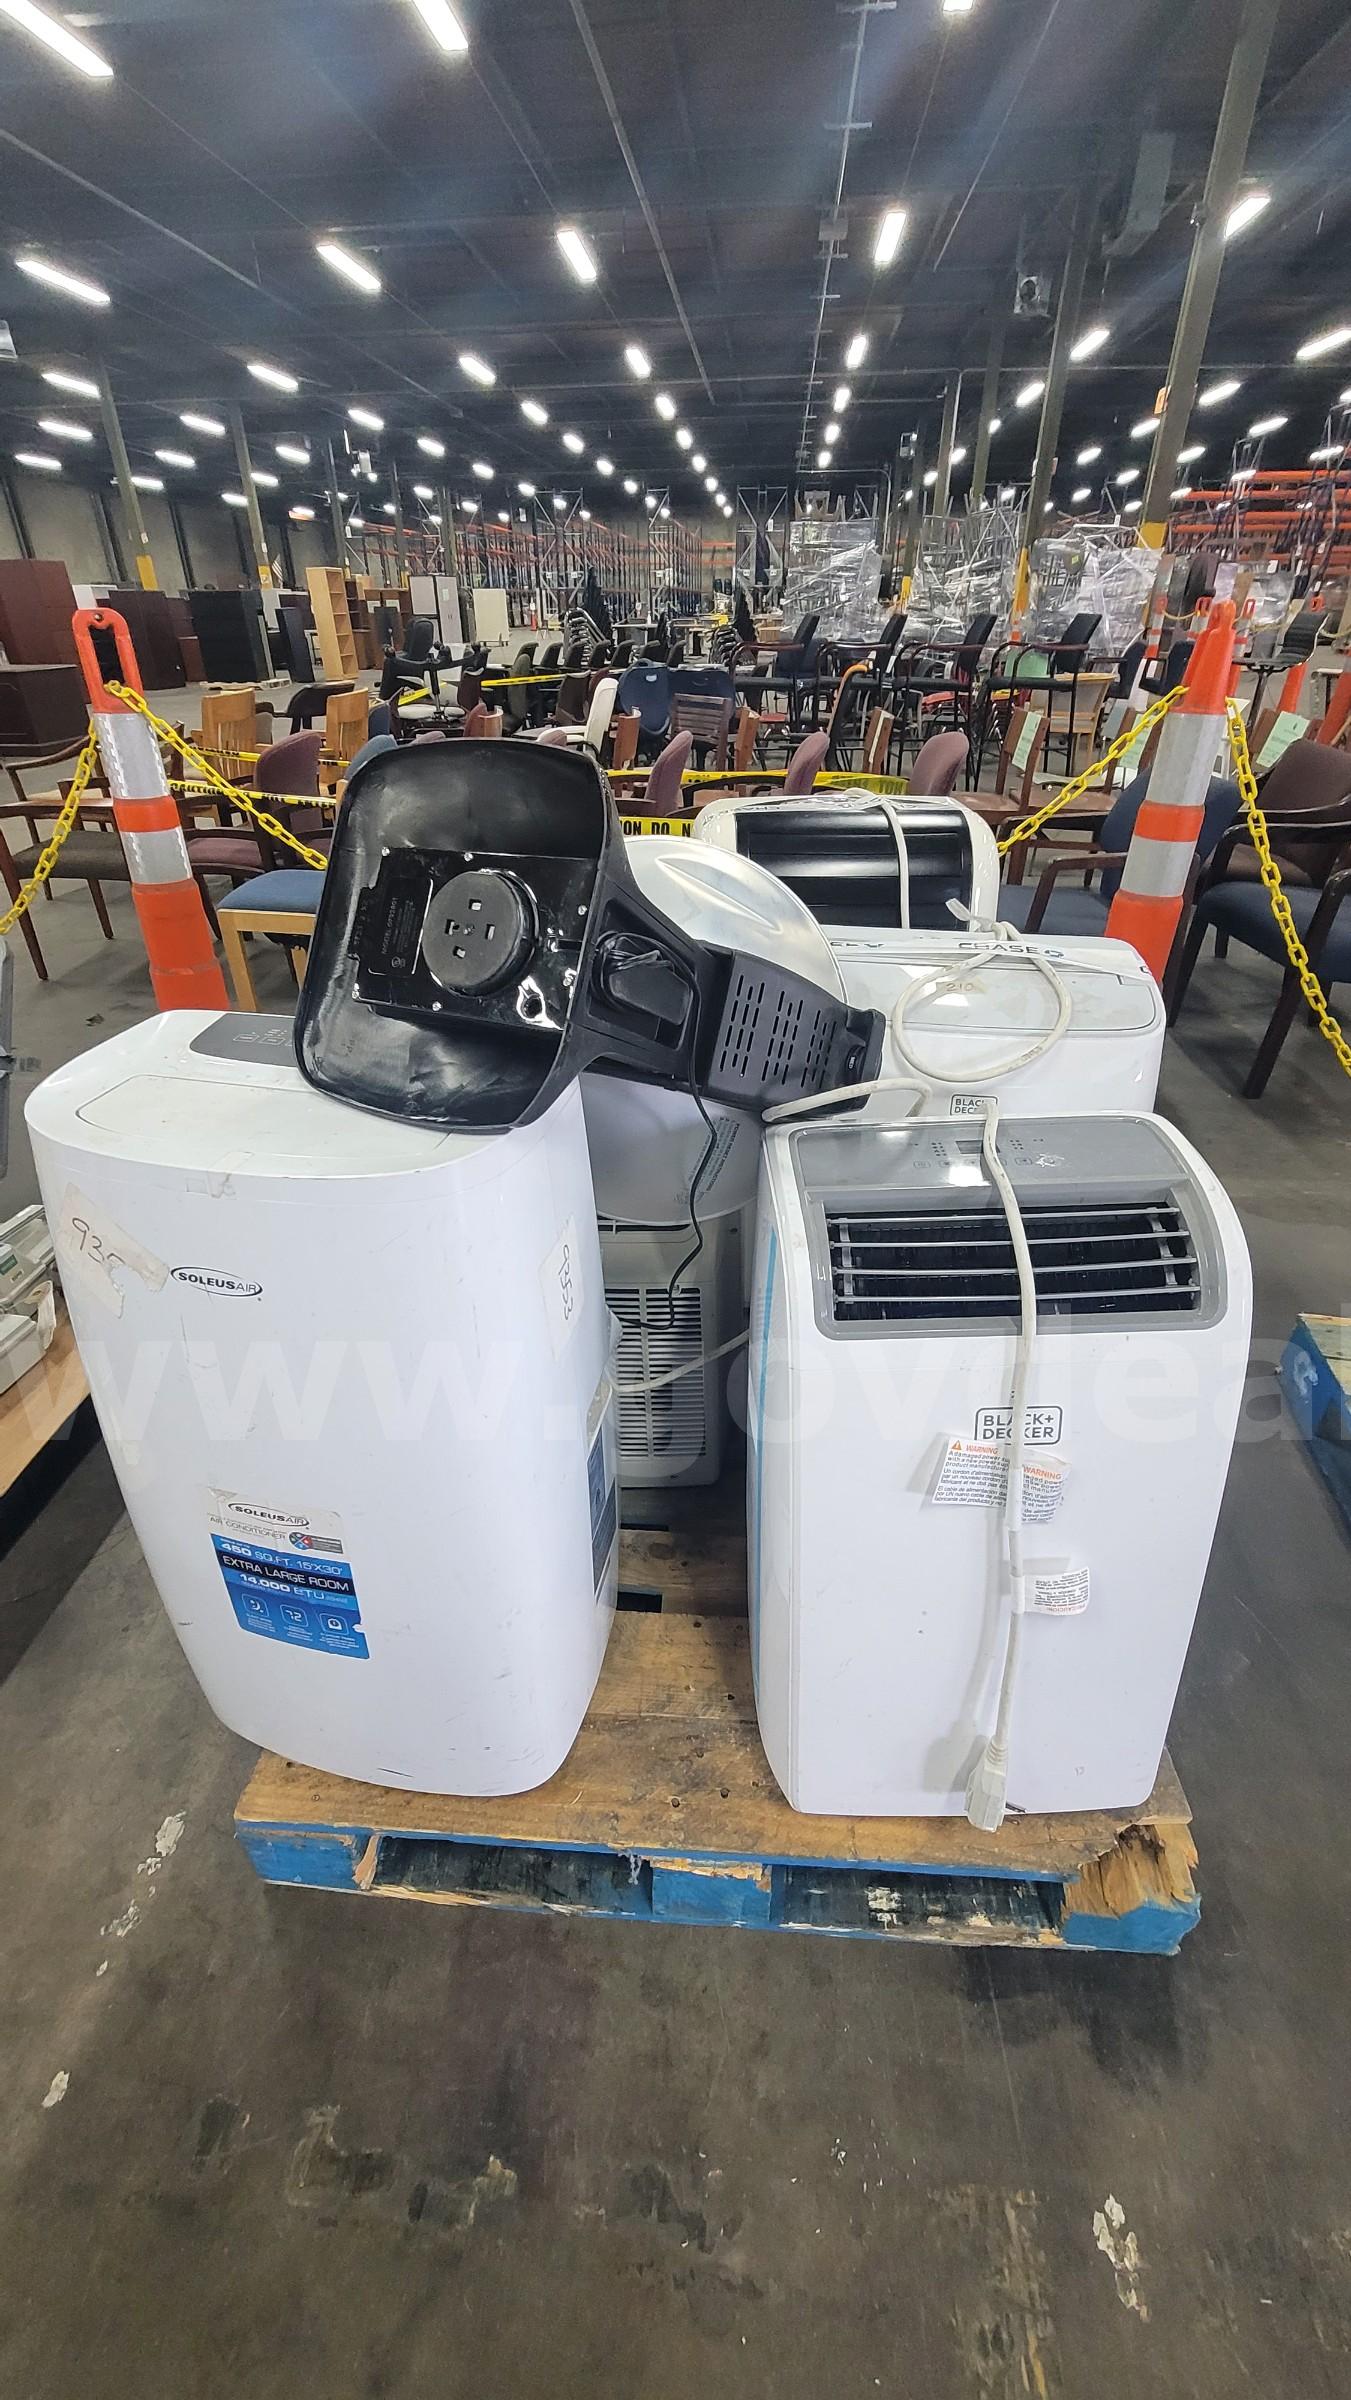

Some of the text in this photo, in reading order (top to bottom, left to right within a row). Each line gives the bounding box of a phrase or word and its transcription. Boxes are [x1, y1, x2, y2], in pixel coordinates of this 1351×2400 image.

[958, 942, 1039, 954] CHASE
[955, 1098, 985, 1107] BLAC
[177, 1271, 258, 1294] SOLEUSAIR
[983, 1413, 1055, 1427] BLK+
[966, 1444, 999, 1455] WARNING
[1023, 1466, 1062, 1480] WARNING
[234, 1506, 306, 1525] SOLEUSAIR
[225, 1520, 286, 1540] CONDITIONER
[222, 1555, 263, 1575] EXTRA
[264, 1565, 306, 1584] LARGE
[308, 1576, 349, 1592] ROOM
[293, 1587, 325, 1600] BTU
